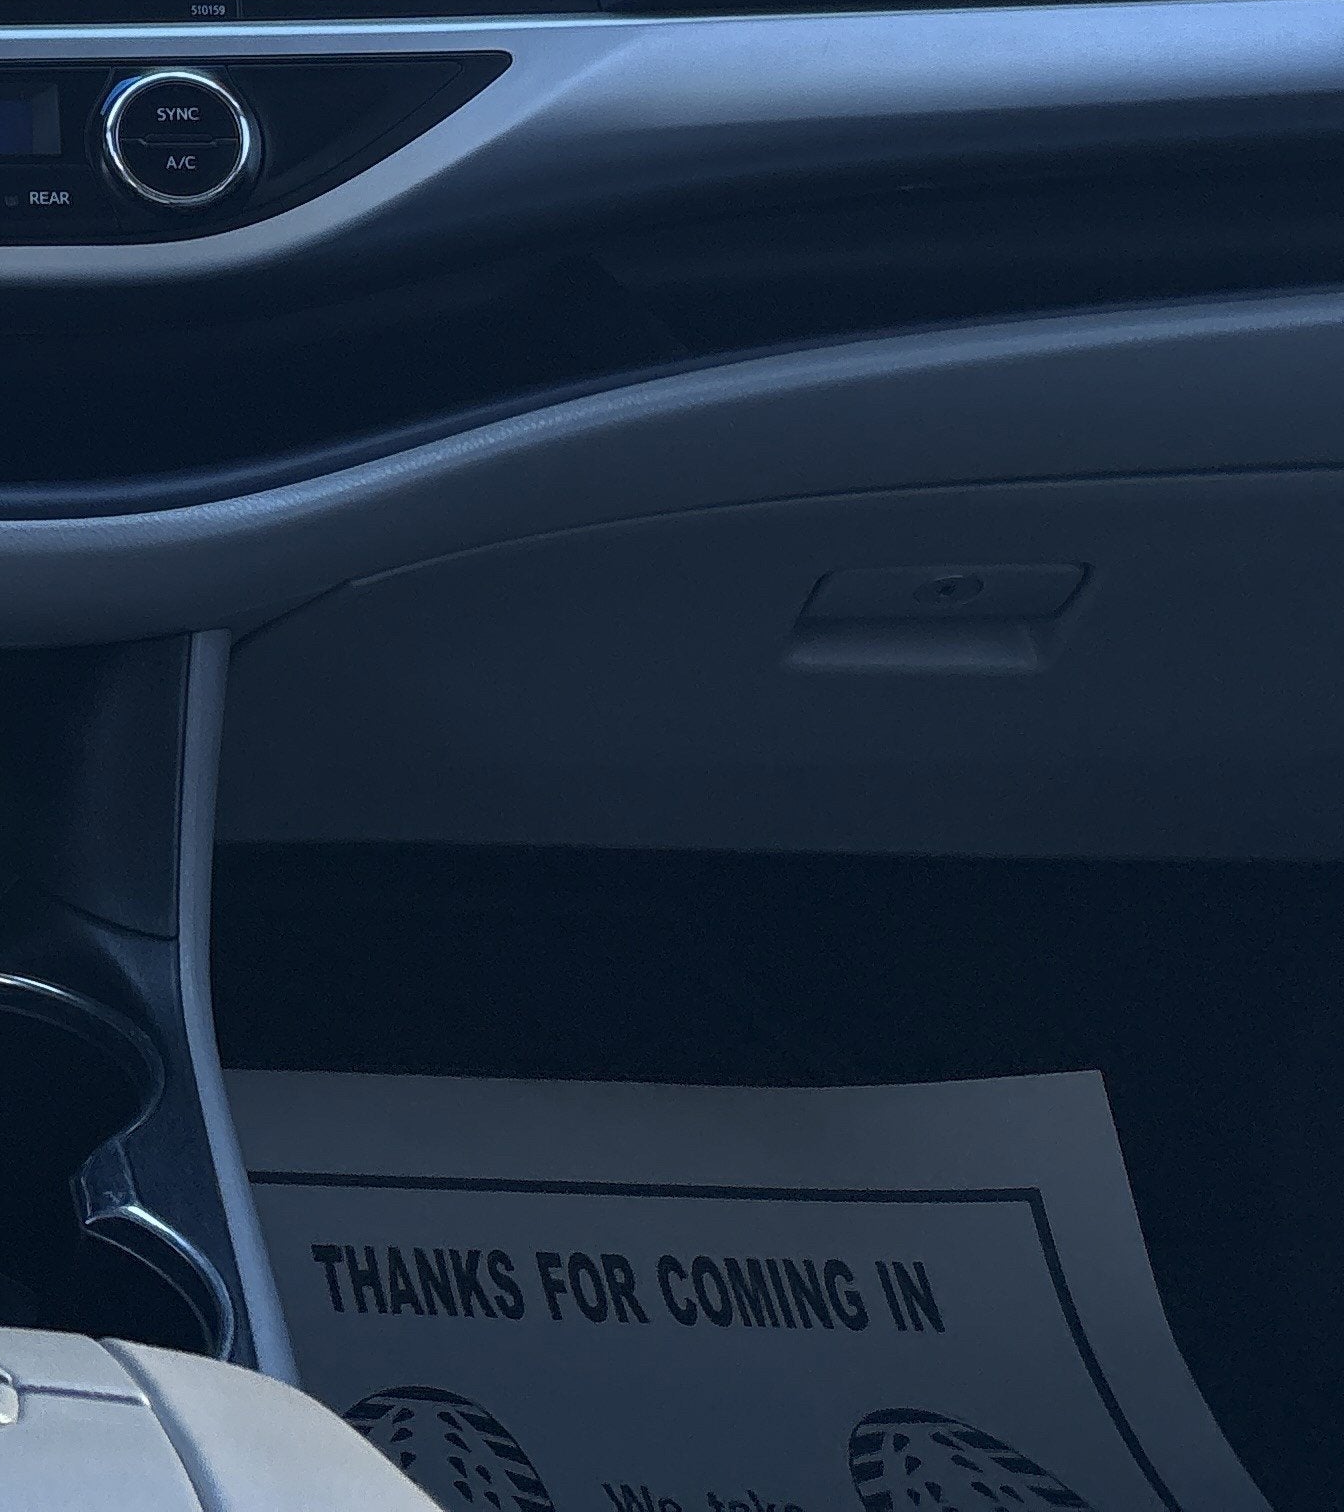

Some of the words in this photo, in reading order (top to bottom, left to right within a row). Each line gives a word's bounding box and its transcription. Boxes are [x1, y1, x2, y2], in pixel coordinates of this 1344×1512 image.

[156, 107, 200, 122] SYNC
[166, 155, 197, 170] A/C
[29, 191, 70, 206] REAR
[312, 1243, 526, 1321] THANKS
[535, 1250, 651, 1325] FOR
[656, 1253, 871, 1334] COMING
[874, 1259, 946, 1336] IN
